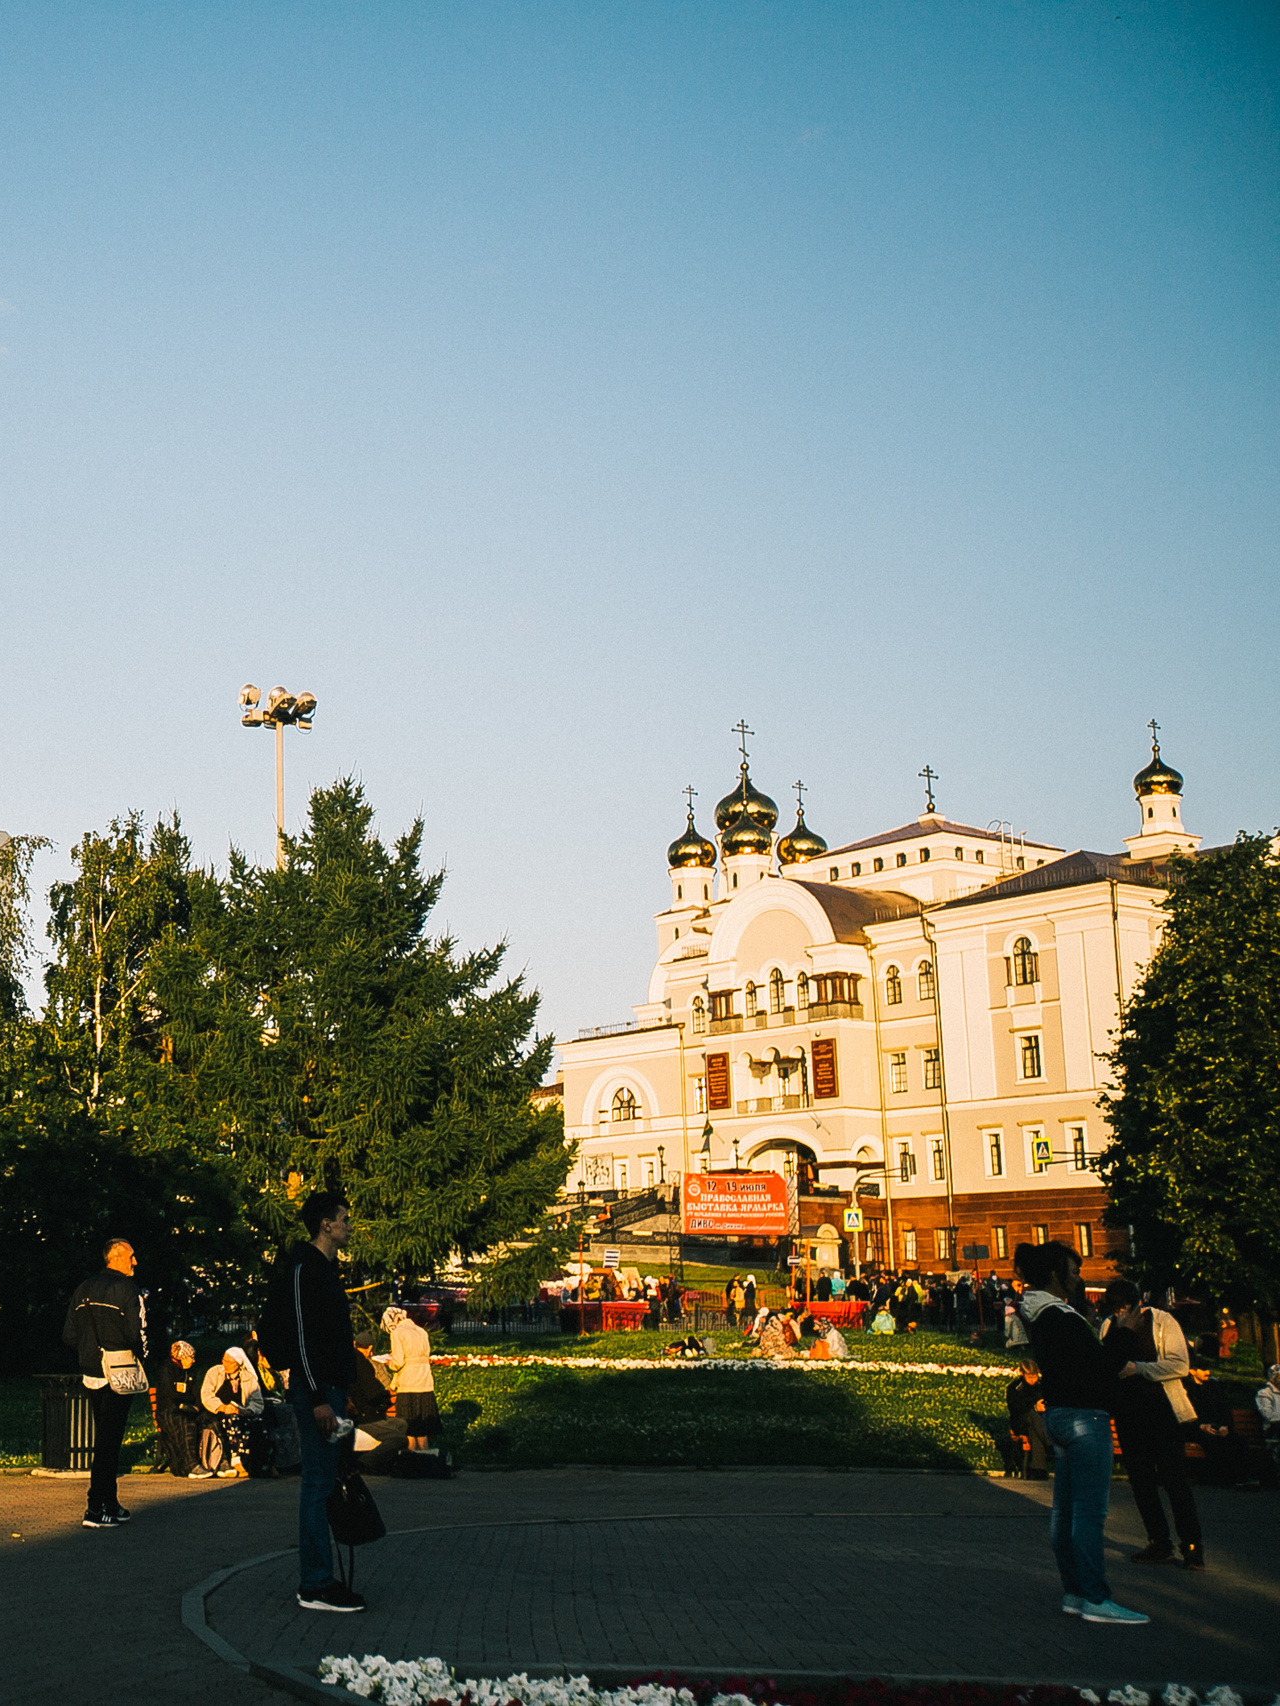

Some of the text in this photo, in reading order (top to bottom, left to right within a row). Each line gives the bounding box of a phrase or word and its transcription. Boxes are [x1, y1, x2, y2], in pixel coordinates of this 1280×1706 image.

[706, 1180, 717, 1191] 12
[726, 1181, 737, 1192] 19
[739, 1183, 766, 1192] июля
[700, 1194, 771, 1202] ПРАВОСЛАВНАЯ
[686, 1202, 785, 1212] ВЫСТАВКА-ЯРМАРКА
[690, 1219, 714, 1229] ДИВС
